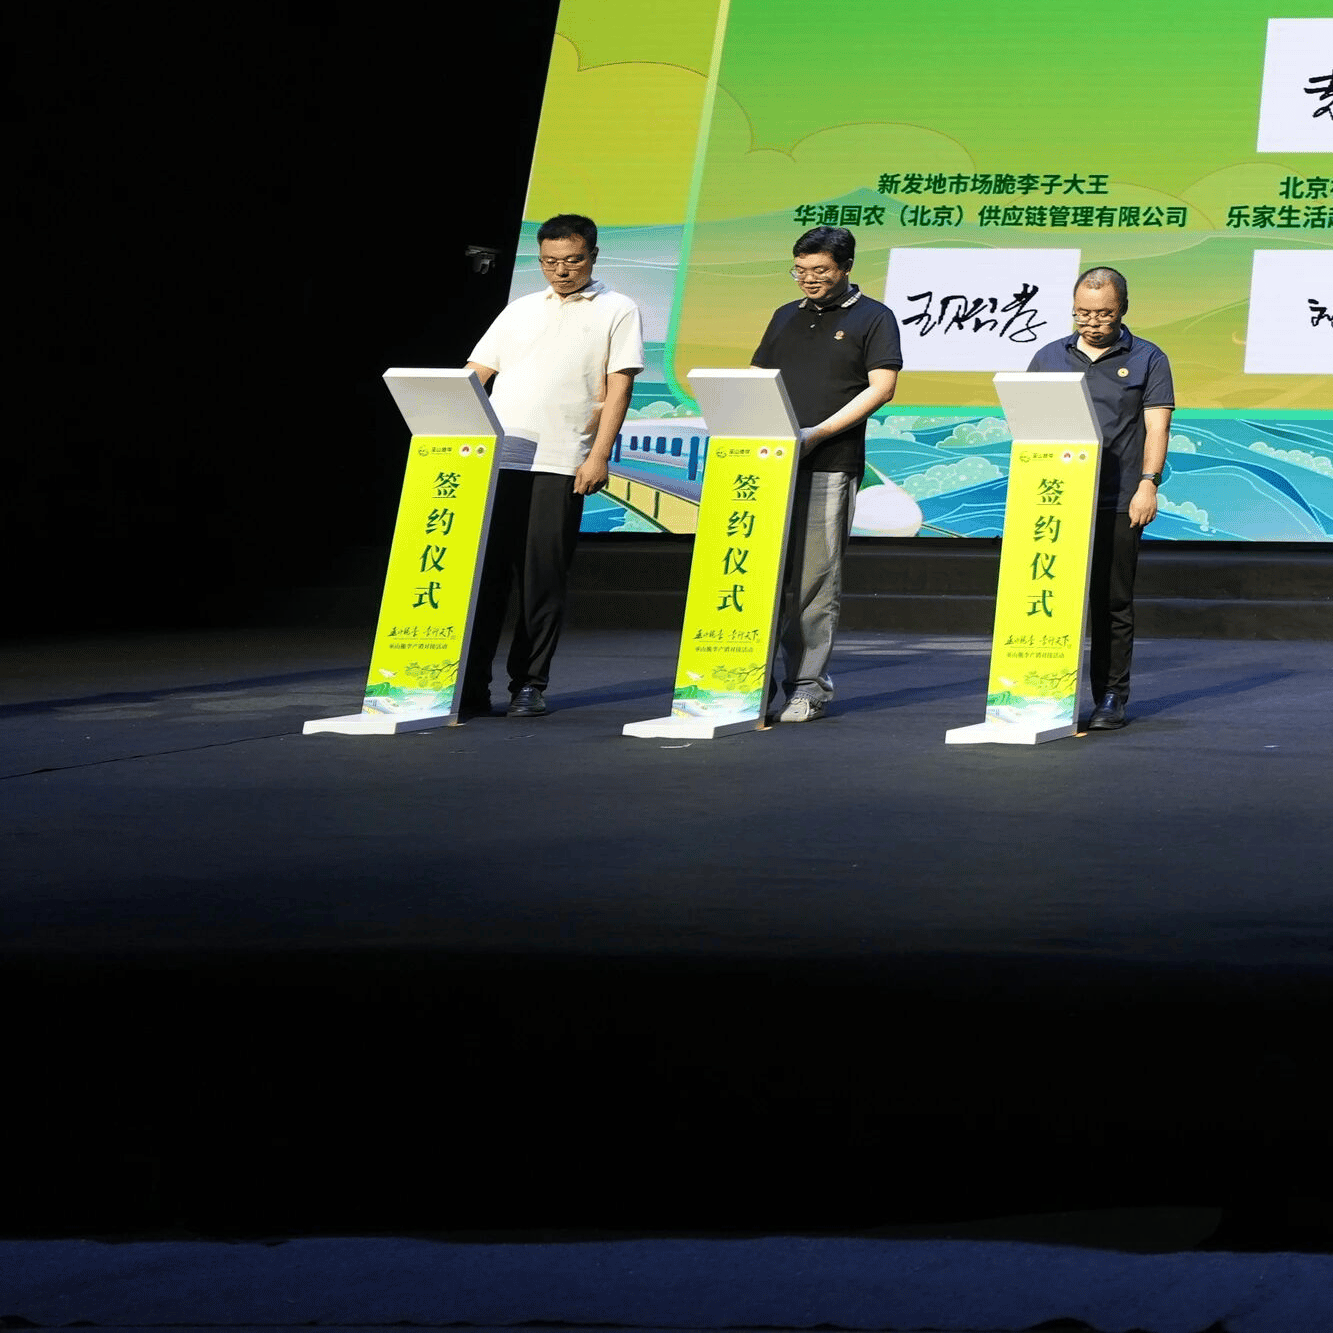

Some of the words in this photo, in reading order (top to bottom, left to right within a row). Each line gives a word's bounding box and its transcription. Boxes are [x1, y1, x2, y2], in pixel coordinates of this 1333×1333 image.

[878, 173, 1109, 195] 新发地市场脆李子大王
[412, 471, 461, 609] 签约仪式
[716, 473, 760, 613] 签约仪式
[1025, 477, 1064, 618] 签约仪式
